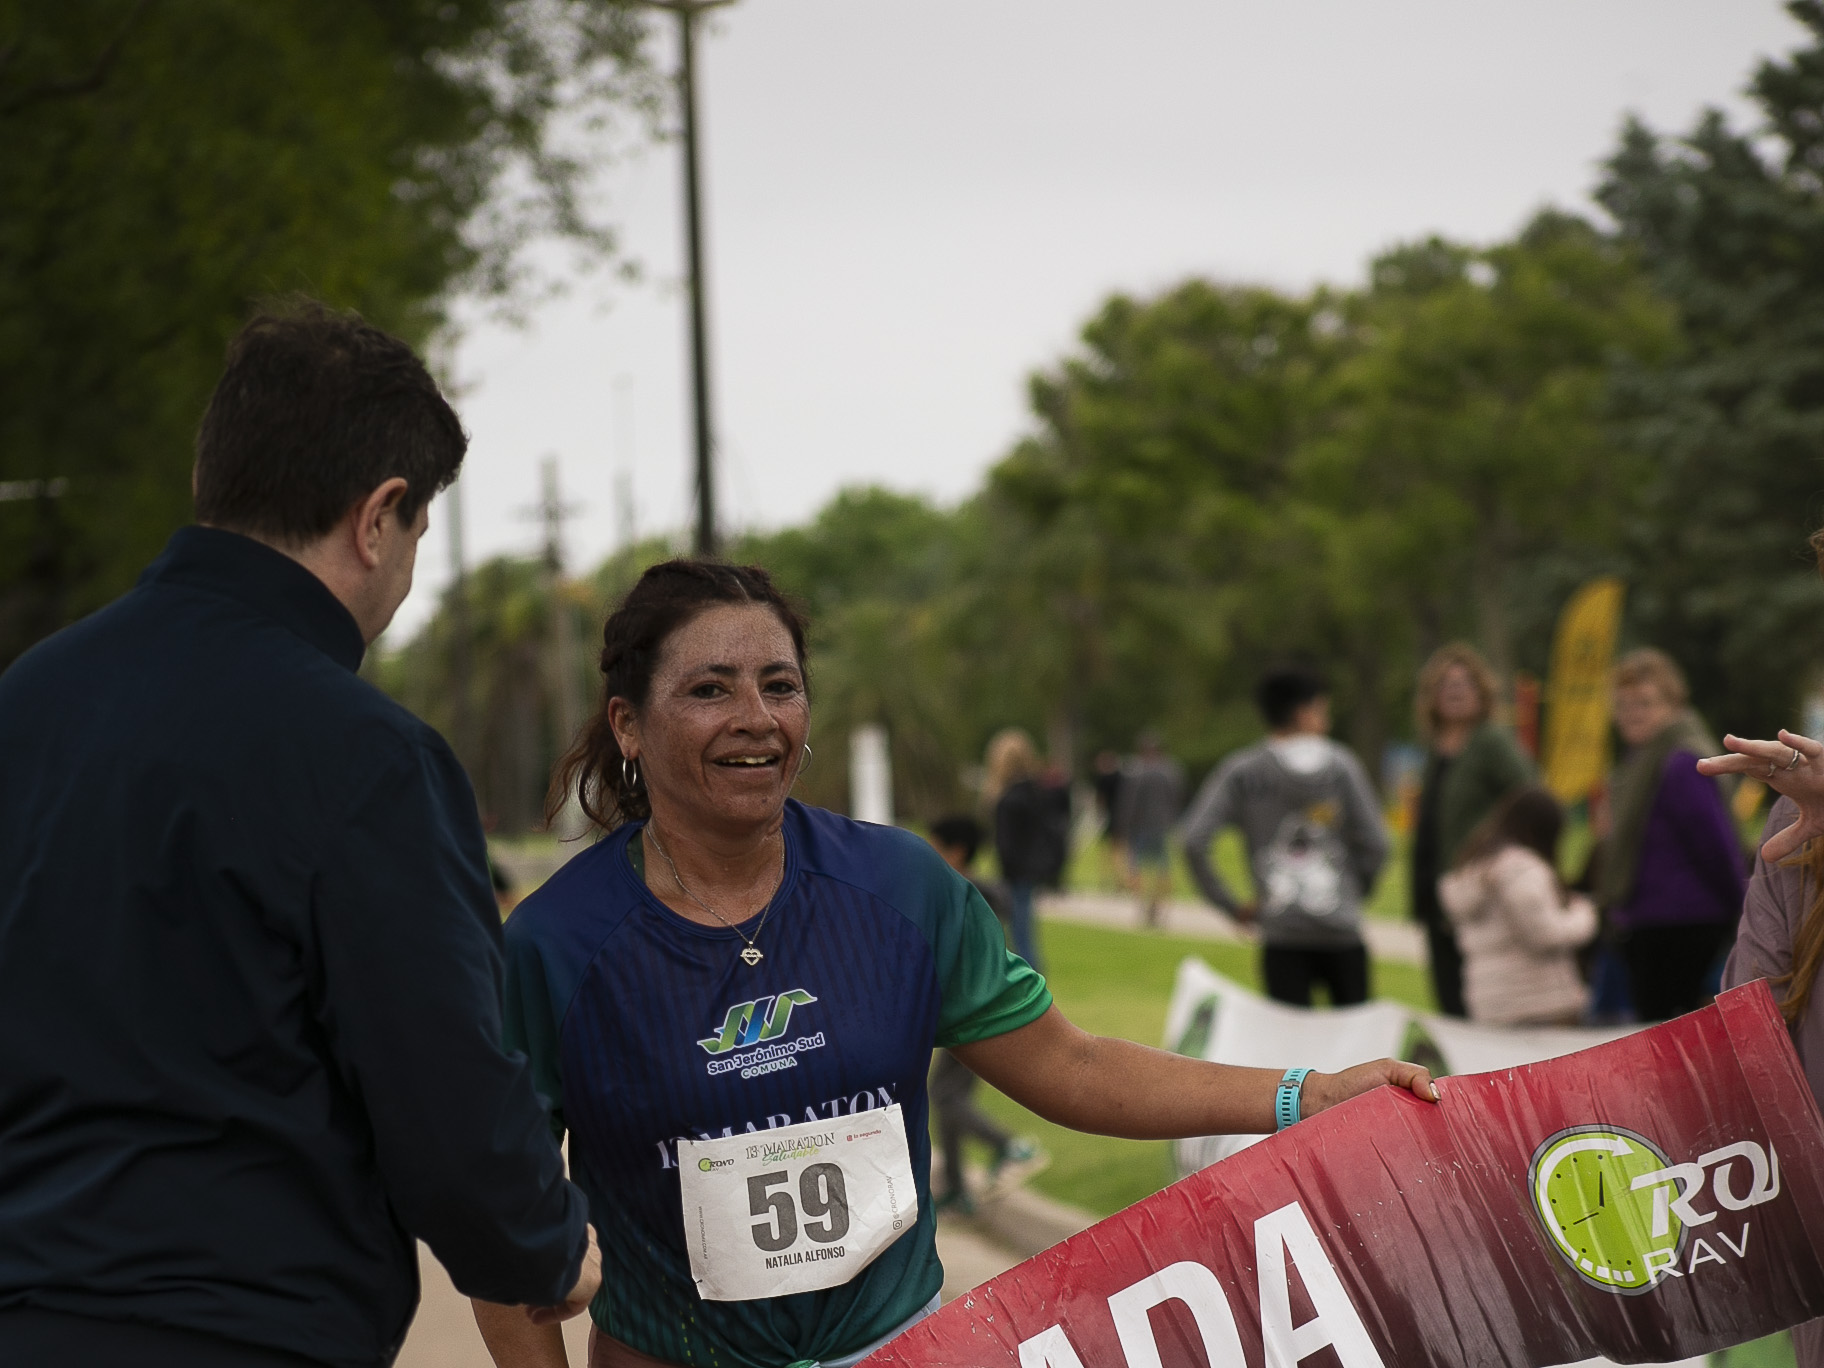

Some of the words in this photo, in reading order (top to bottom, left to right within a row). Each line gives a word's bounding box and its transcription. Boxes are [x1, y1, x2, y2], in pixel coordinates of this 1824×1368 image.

[708, 1061, 734, 1074] San
[734, 1044, 796, 1067] Jerónimo
[797, 1032, 824, 1051] Sud
[742, 1057, 797, 1078] COMUNA
[760, 1132, 835, 1157] MARATON
[762, 1144, 820, 1166] Saludable
[747, 1162, 850, 1252] 59
[765, 1252, 803, 1269] NATALIA
[805, 1245, 845, 1263] ALFONSO
[1643, 1222, 1749, 1284] RAV
